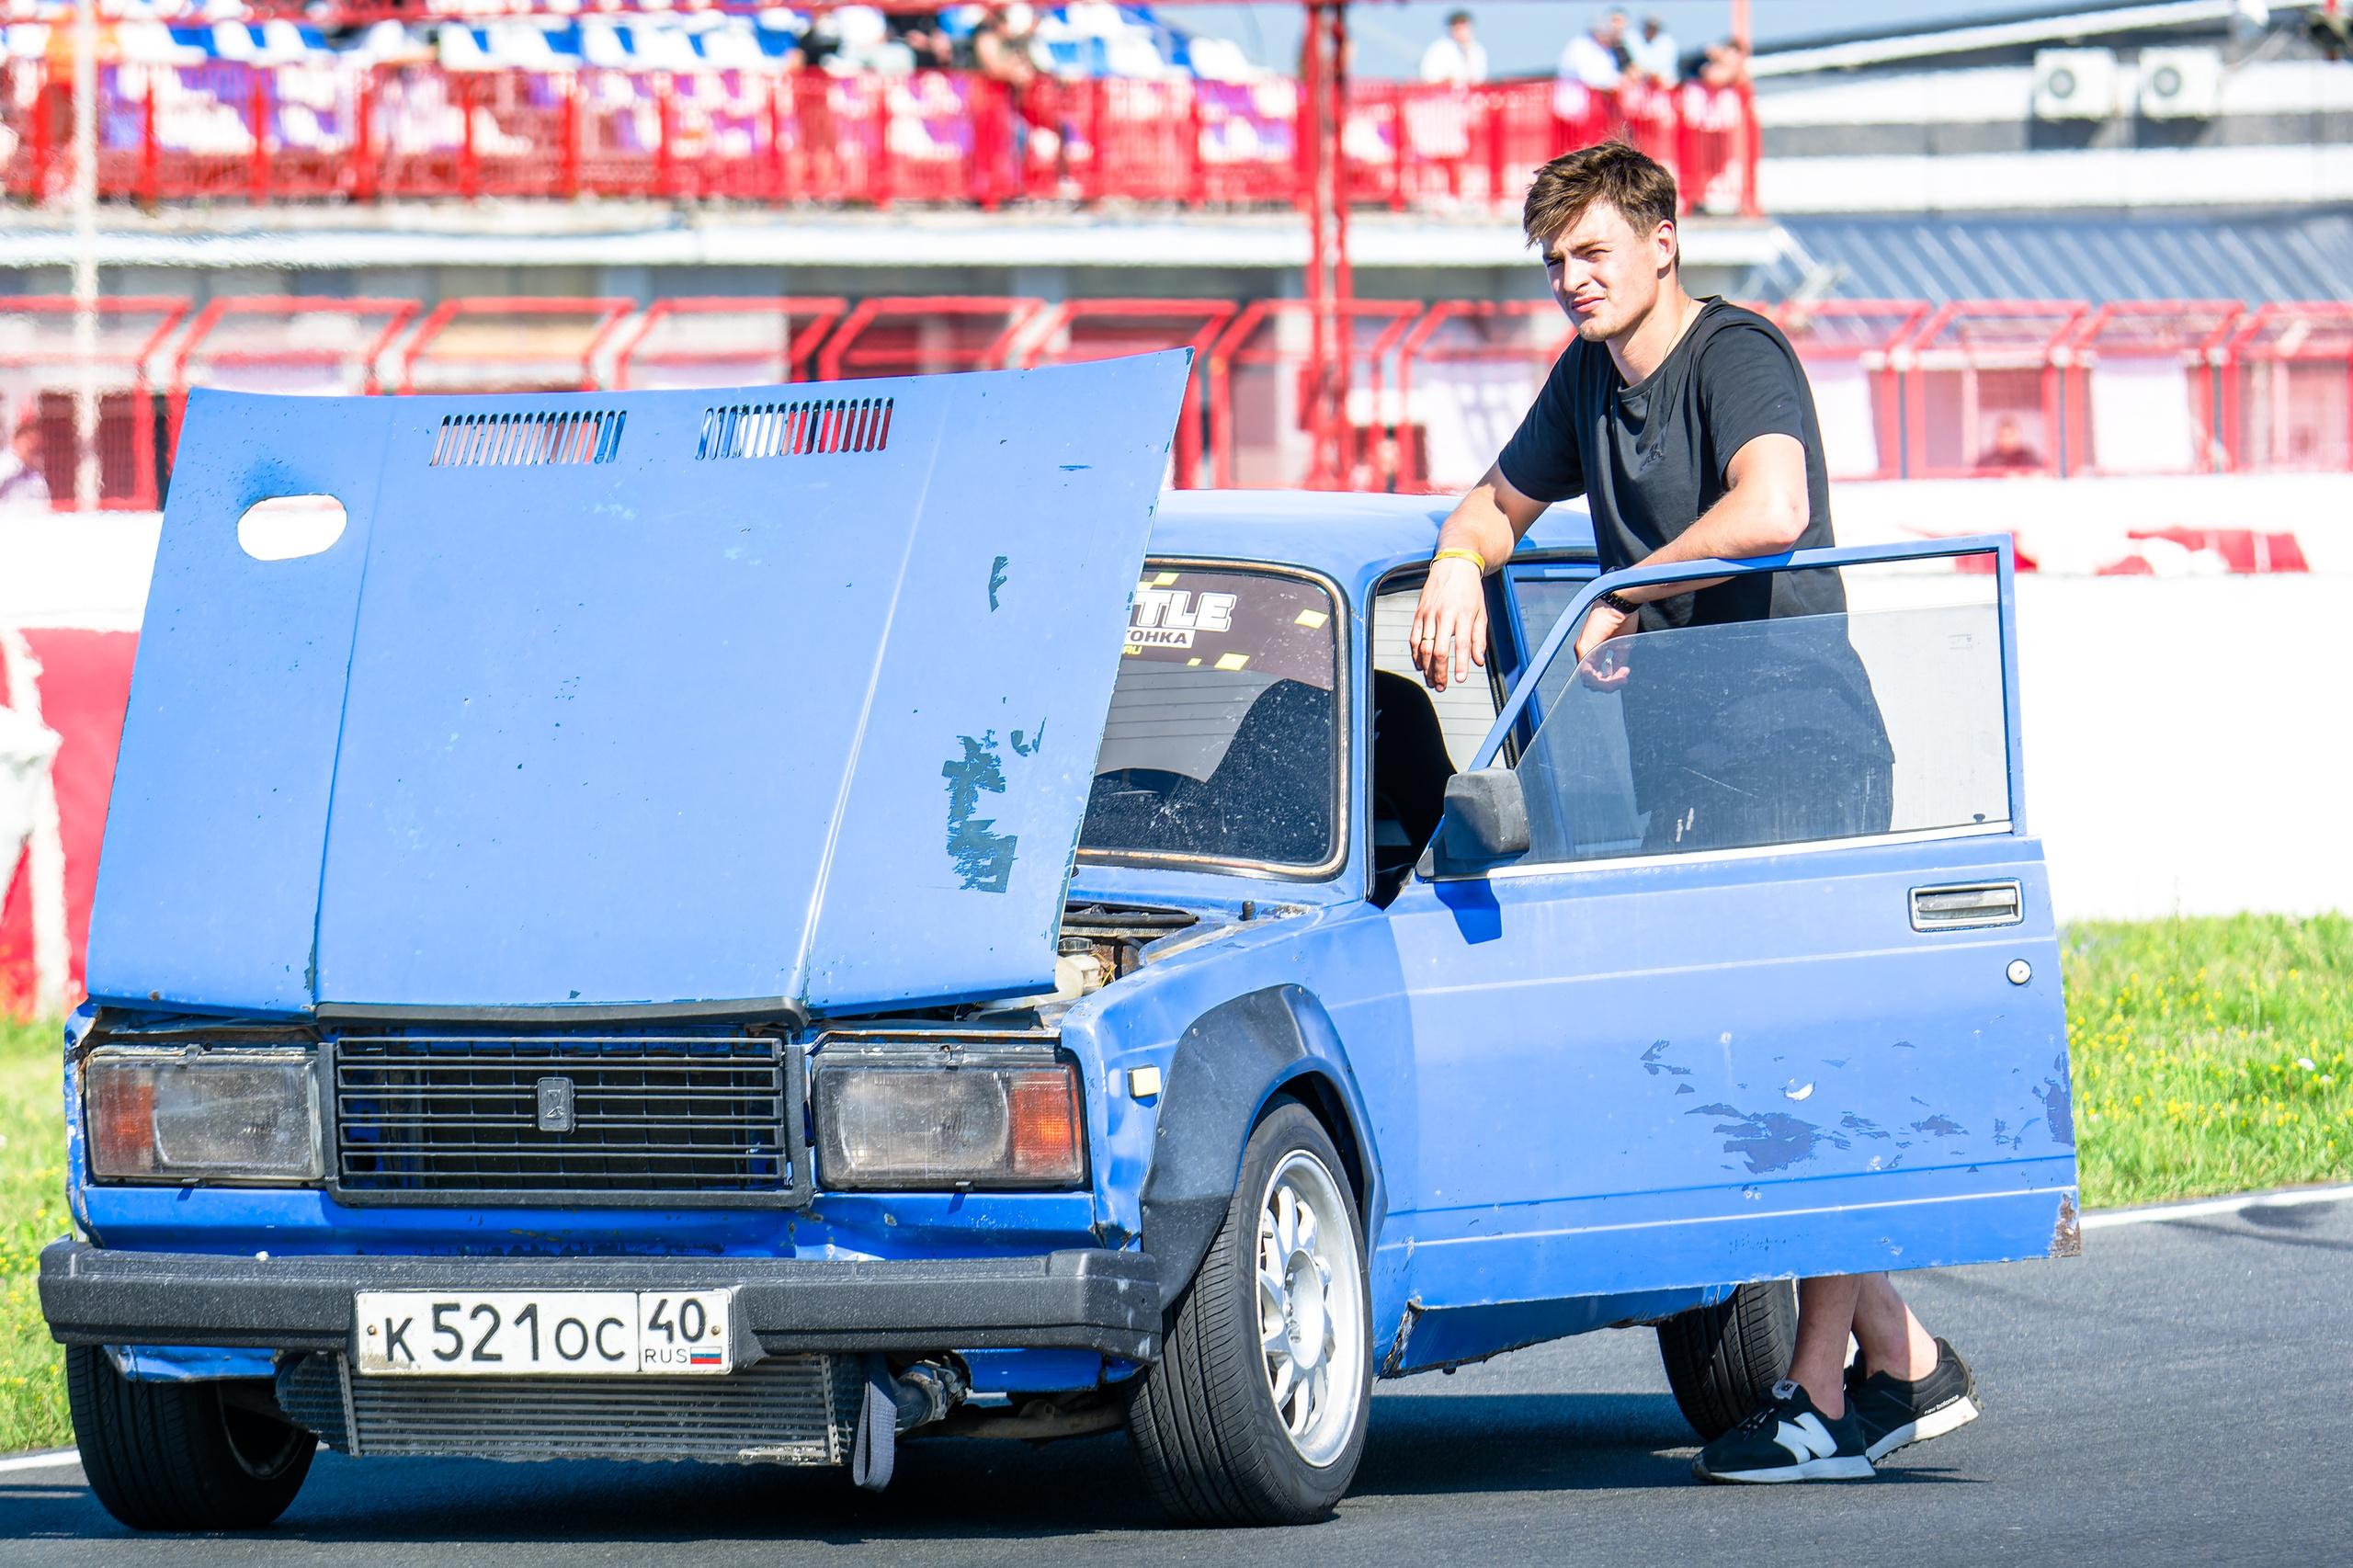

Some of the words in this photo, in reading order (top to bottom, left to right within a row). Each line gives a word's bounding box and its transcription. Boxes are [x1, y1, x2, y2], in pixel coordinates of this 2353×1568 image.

[1128, 630, 1188, 644] ОНКА
[647, 1297, 706, 1344] 40
[644, 1347, 688, 1364] RUS
